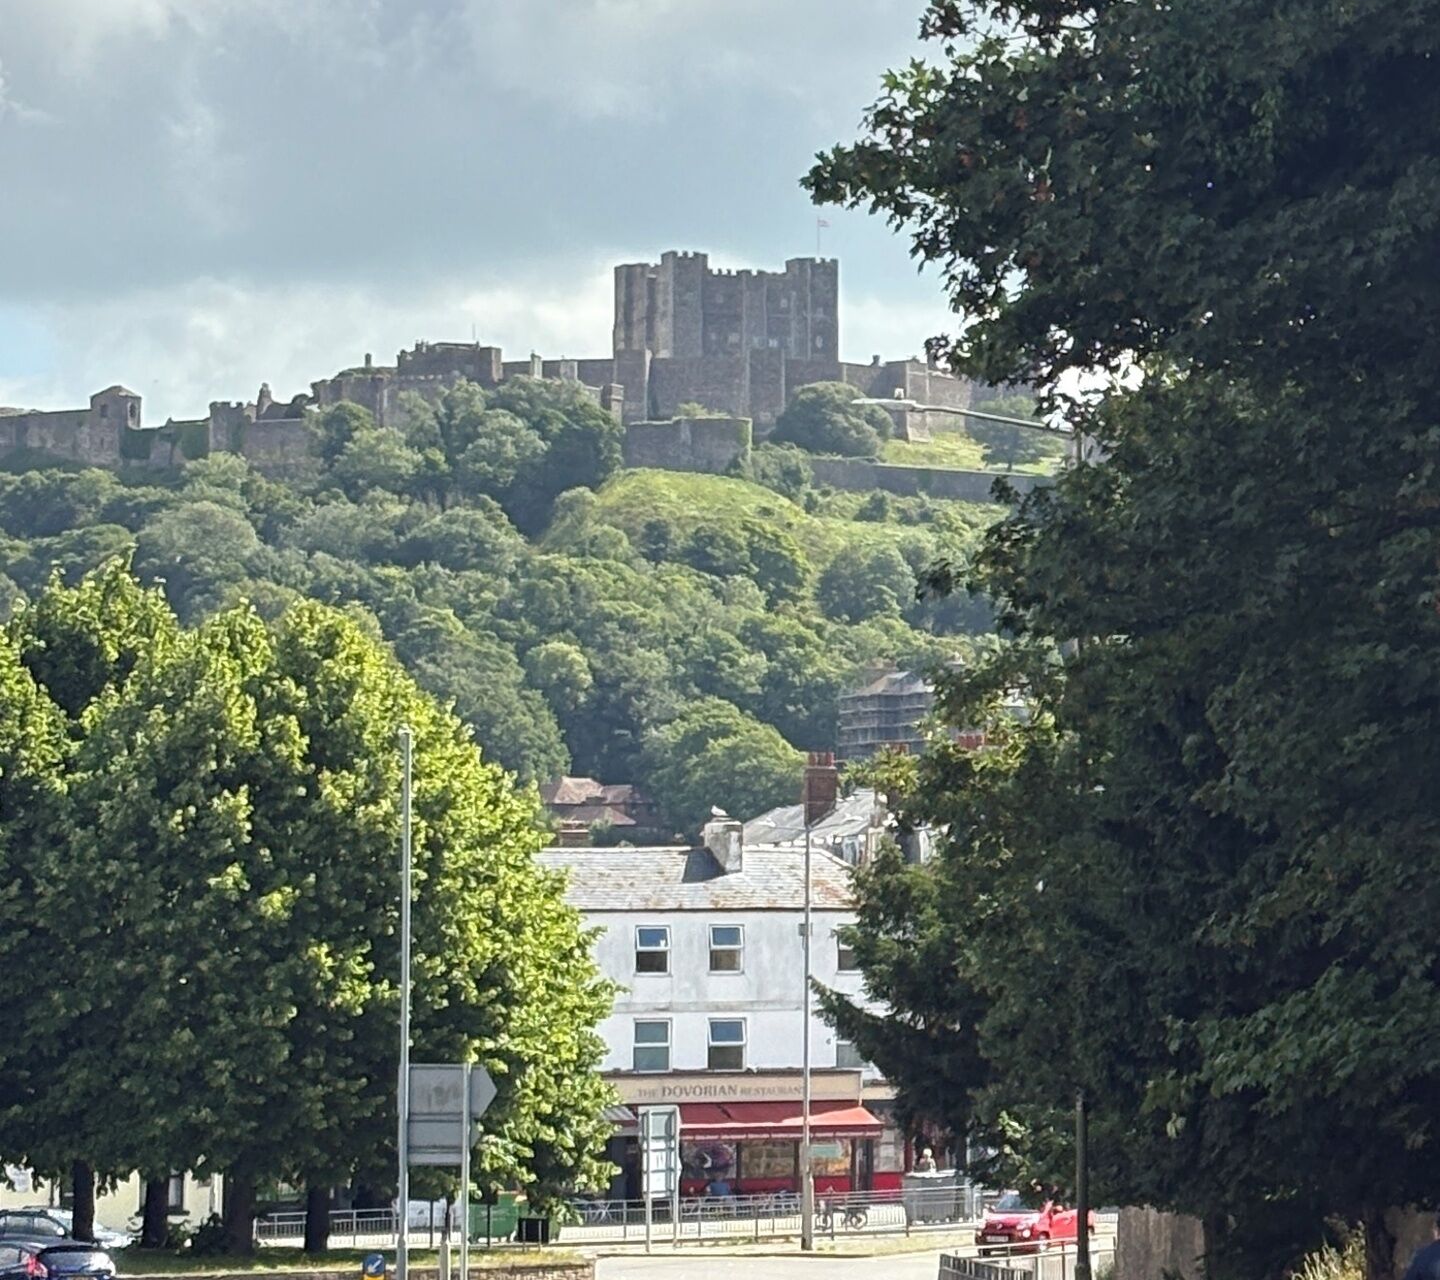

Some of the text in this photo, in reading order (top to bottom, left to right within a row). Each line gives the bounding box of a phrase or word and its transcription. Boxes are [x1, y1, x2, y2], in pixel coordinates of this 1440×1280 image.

[638, 1085, 803, 1098] THE DOVORIAN RESTAURAN
